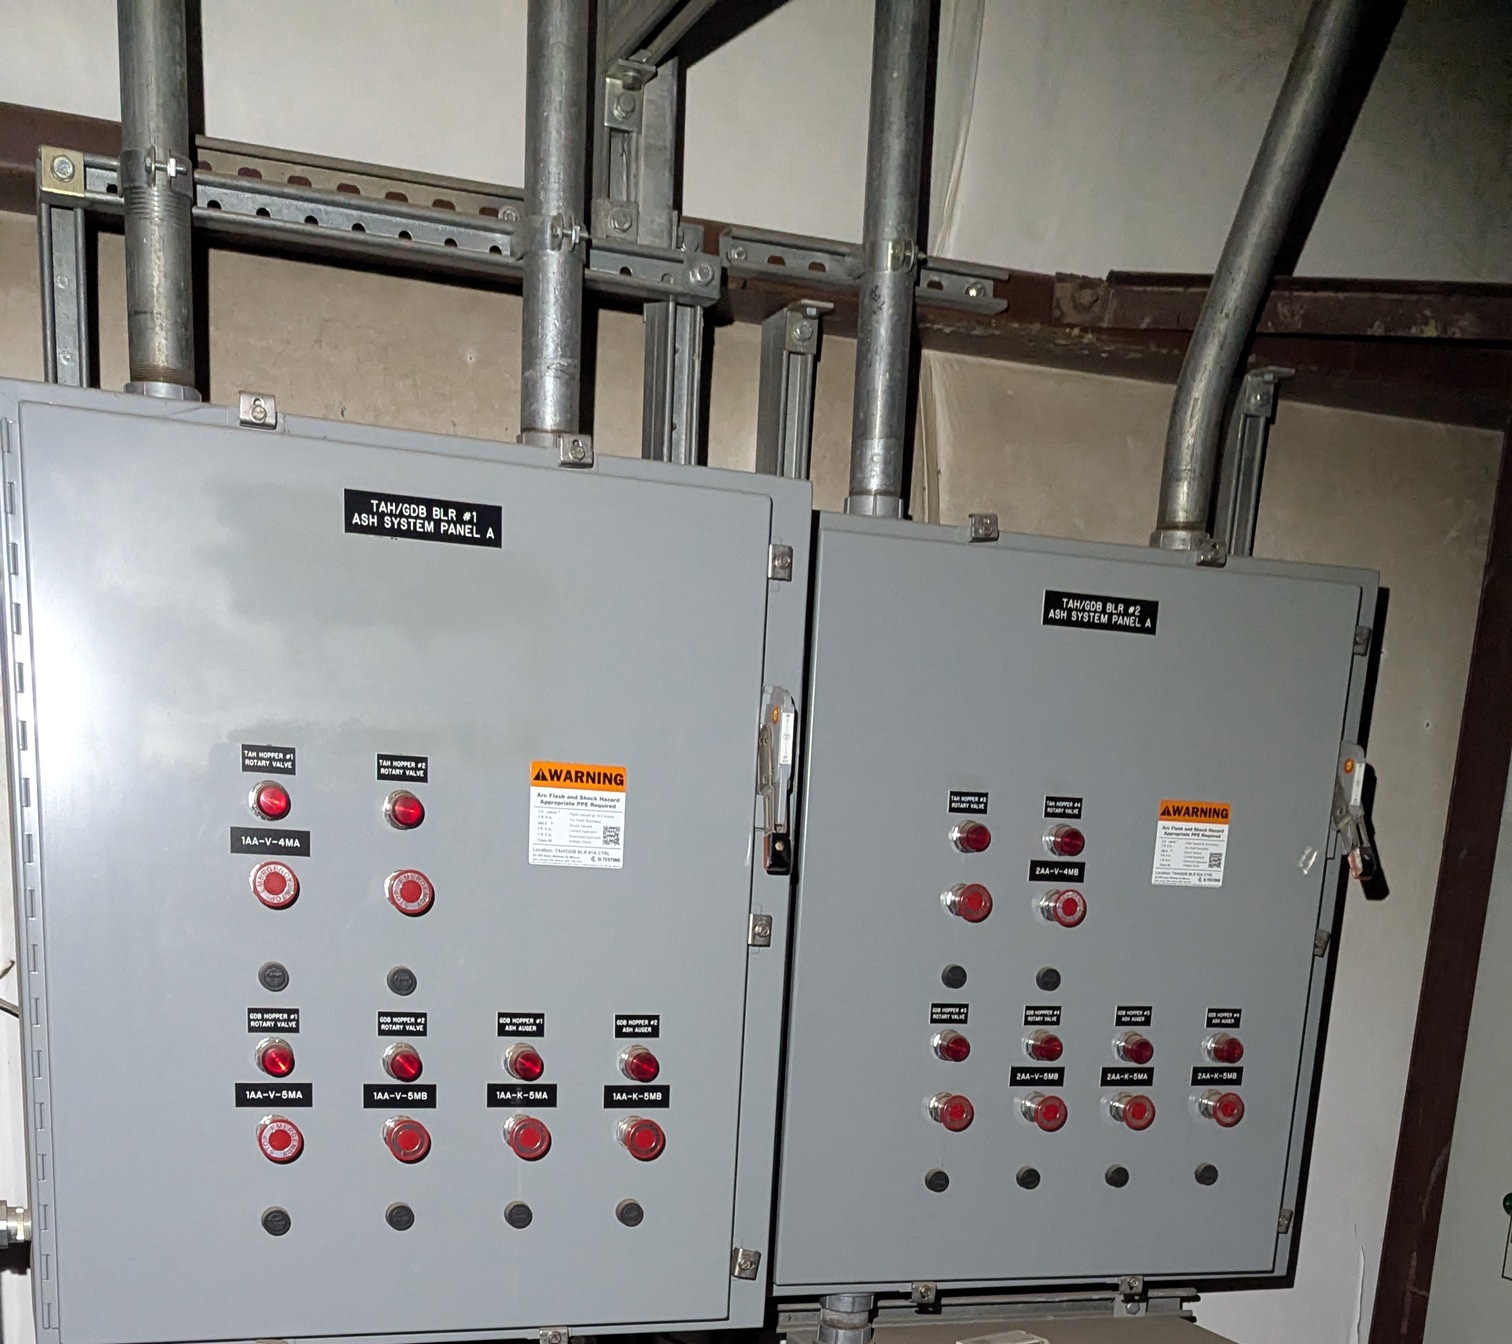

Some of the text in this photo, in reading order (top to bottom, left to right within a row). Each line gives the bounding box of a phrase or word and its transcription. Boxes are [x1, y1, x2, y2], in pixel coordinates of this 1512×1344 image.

[370, 499, 477, 523] TAH/GDB BLR #1
[351, 512, 495, 539] ASH SYSTEM PANEL A
[1062, 597, 1141, 616] TAH/GDB BLR #2
[1048, 608, 1151, 628] ASH SYSTEM PANEL A
[243, 750, 257, 758] TAH
[258, 751, 284, 760] HOPPER
[244, 758, 292, 769] ROTARY VALVE
[392, 760, 416, 768] HOPPER
[380, 767, 424, 777] ROTARY VALVE
[548, 769, 624, 786] WARNING
[1172, 806, 1228, 819] WARNING
[241, 835, 300, 848] 1AA-V-4MA
[249, 1012, 262, 1020] GDB
[263, 1012, 288, 1020] HOPPER
[392, 1016, 415, 1024] HOPPER
[276, 1020, 297, 1028] VALVE
[380, 1023, 404, 1031] ROTARY
[1106, 1072, 1148, 1080] 2AA-K-5MA
[1197, 1072, 1237, 1080] 2AA-K-5MB
[245, 1090, 303, 1099] 1AA-V-5MA
[373, 1091, 428, 1100] 1AA-V-5MB
[496, 1091, 548, 1100] 1AA-K-5MA
[612, 1092, 662, 1100] 1AA-K-5MB
